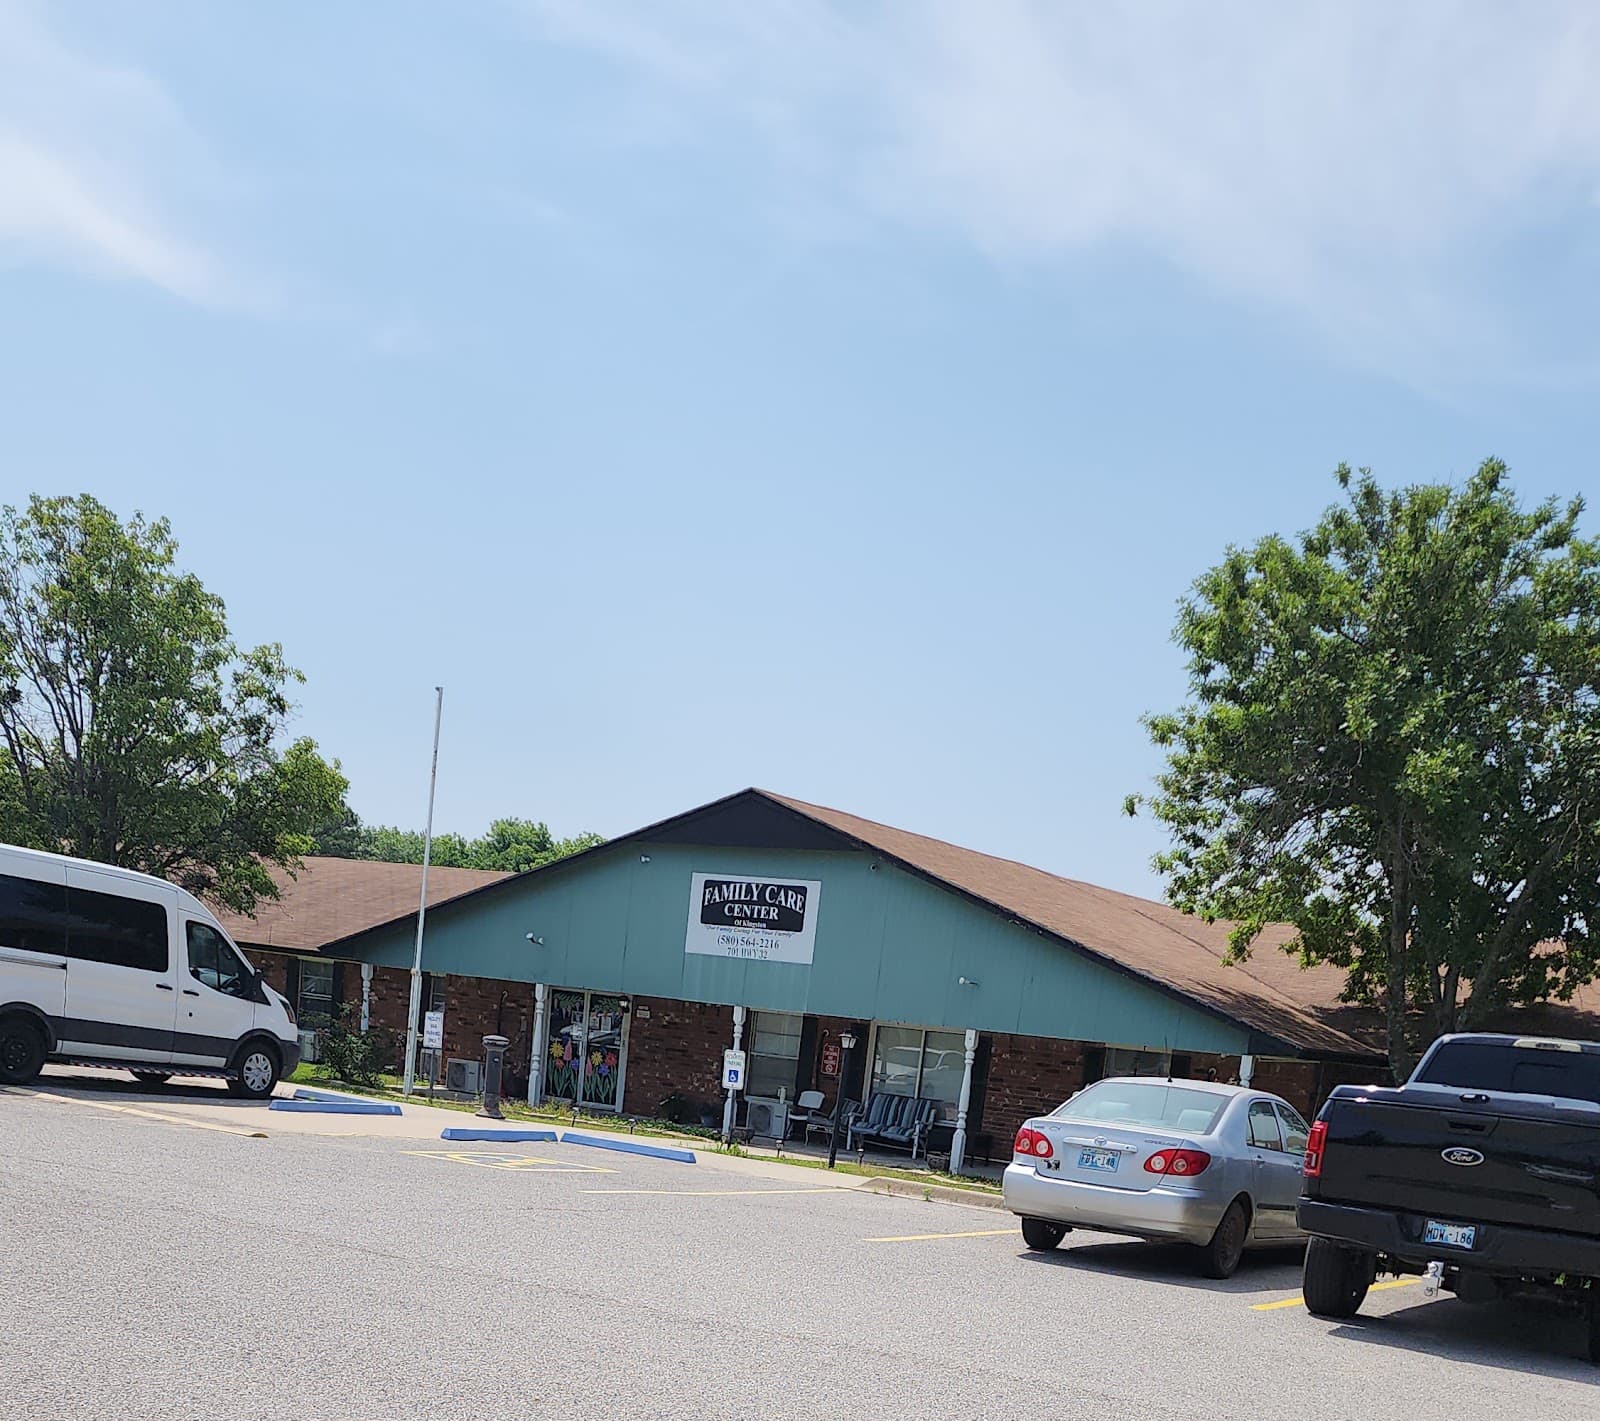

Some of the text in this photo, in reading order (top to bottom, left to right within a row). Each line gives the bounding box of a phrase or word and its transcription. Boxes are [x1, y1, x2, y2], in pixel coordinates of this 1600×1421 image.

[704, 883, 804, 914] FAMILY CARE
[724, 903, 779, 920] CENTER
[717, 935, 780, 950] (580) 564-2216
[727, 947, 768, 959] 701 HWY 32
[1450, 1150, 1474, 1162] Ford
